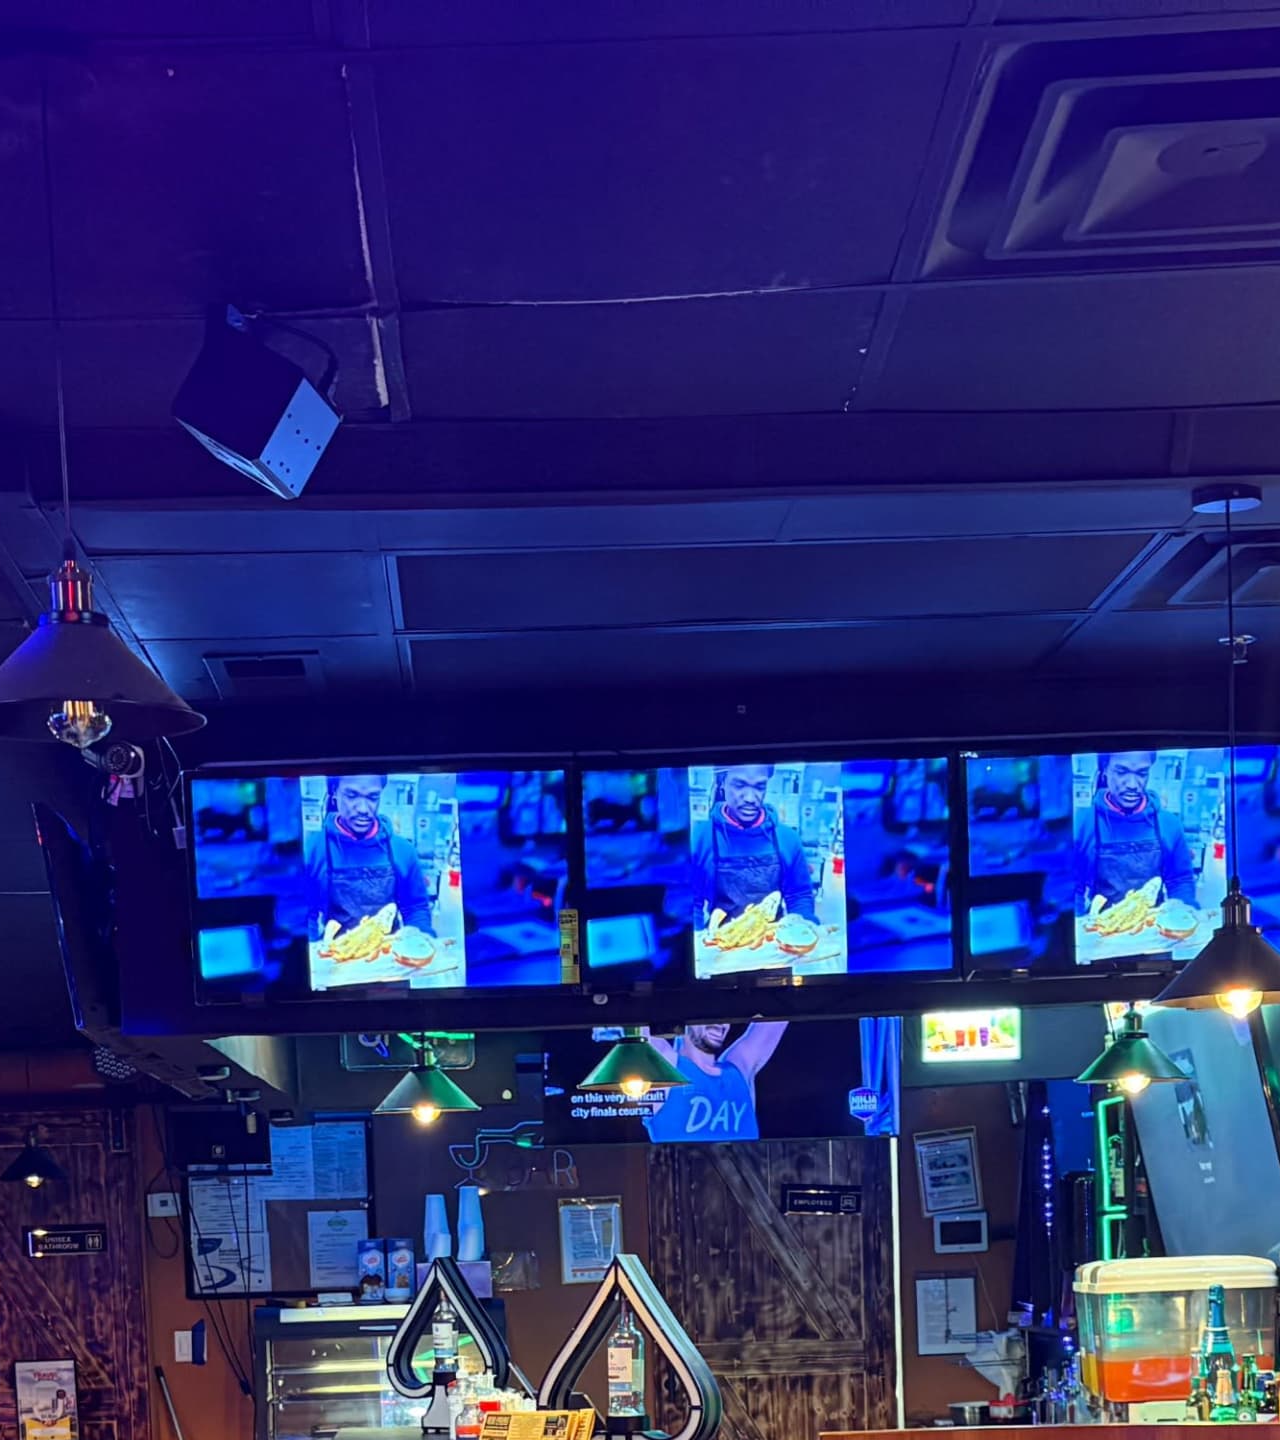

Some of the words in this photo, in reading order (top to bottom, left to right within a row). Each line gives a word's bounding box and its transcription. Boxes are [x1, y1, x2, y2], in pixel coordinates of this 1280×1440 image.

[585, 1092, 603, 1104] this
[604, 1093, 625, 1105] very
[627, 1090, 664, 1102] dficult
[571, 1107, 589, 1119] city
[590, 1106, 617, 1117] finals
[686, 1095, 747, 1133] DAY
